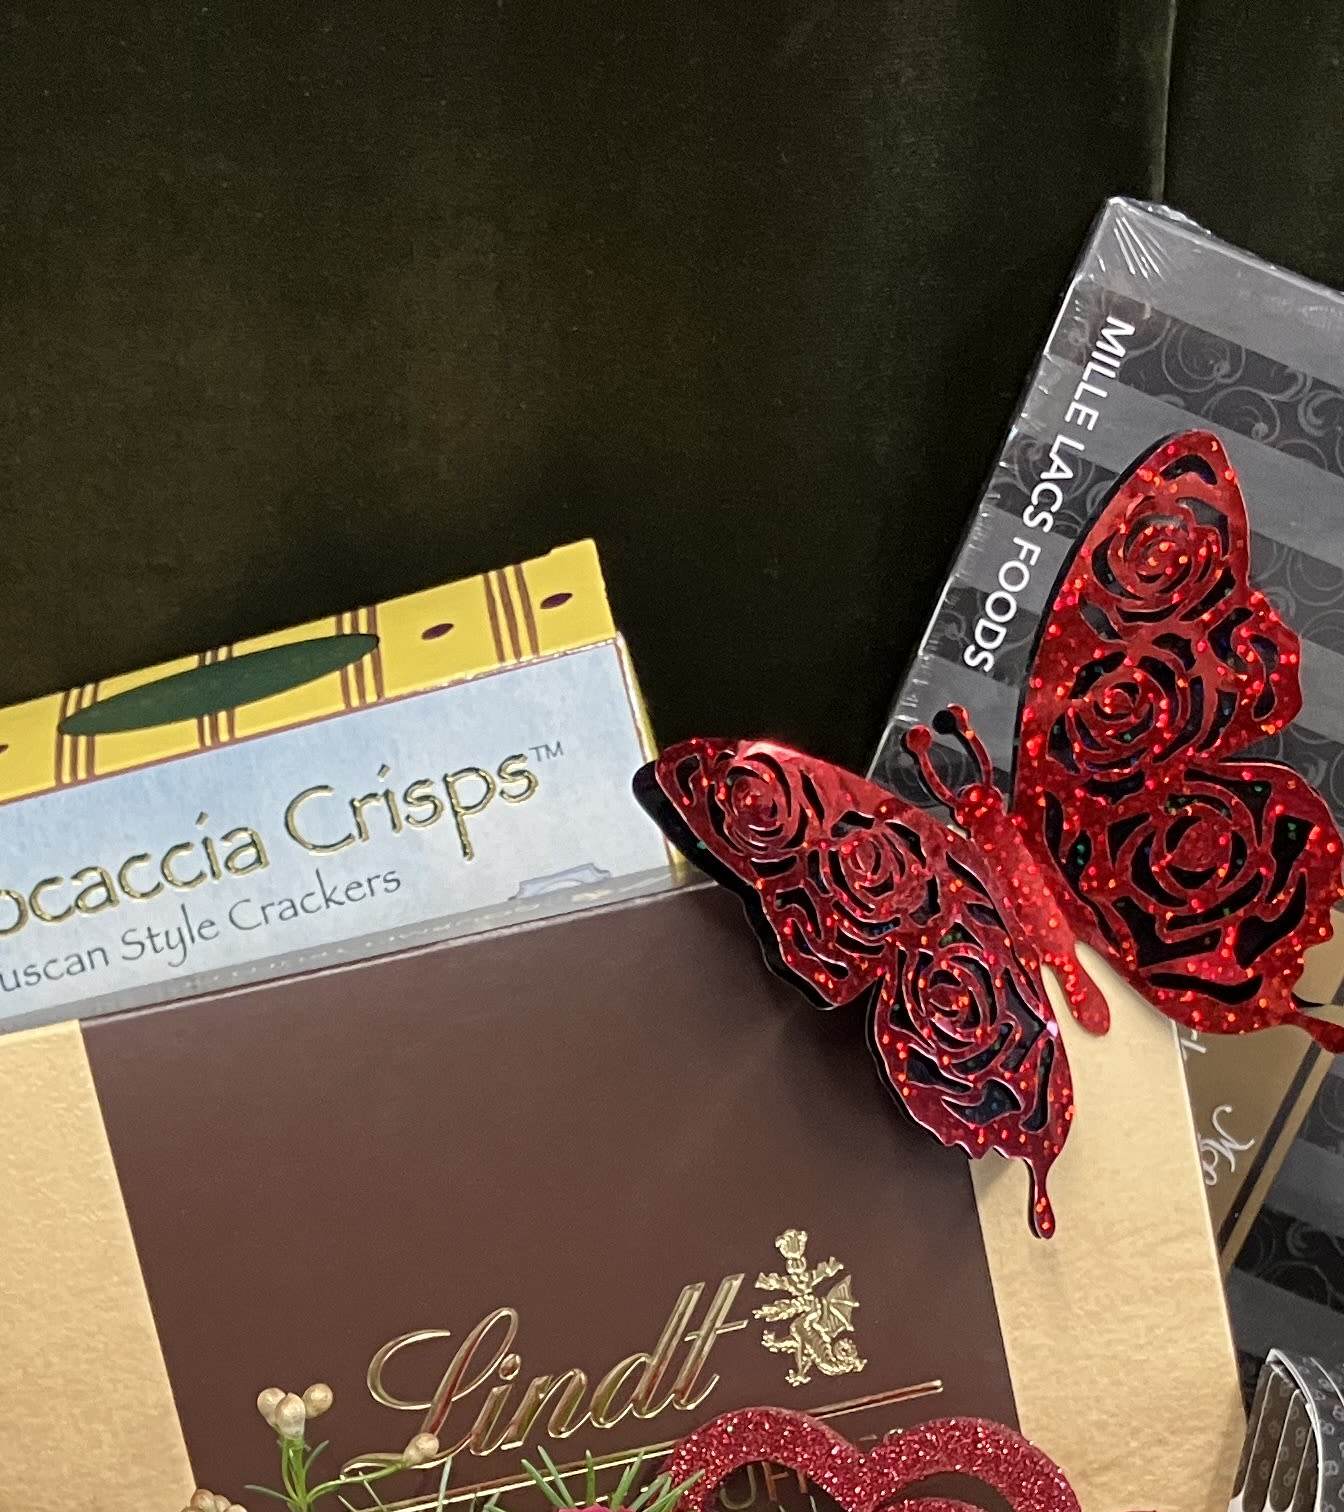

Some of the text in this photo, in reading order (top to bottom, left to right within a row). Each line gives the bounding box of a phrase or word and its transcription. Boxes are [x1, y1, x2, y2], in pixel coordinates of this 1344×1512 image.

[963, 316, 1135, 673] MILLE LACS FOODS
[121, 904, 220, 968] Style
[229, 867, 402, 932] Crackers
[340, 1272, 748, 1480] Lindt
